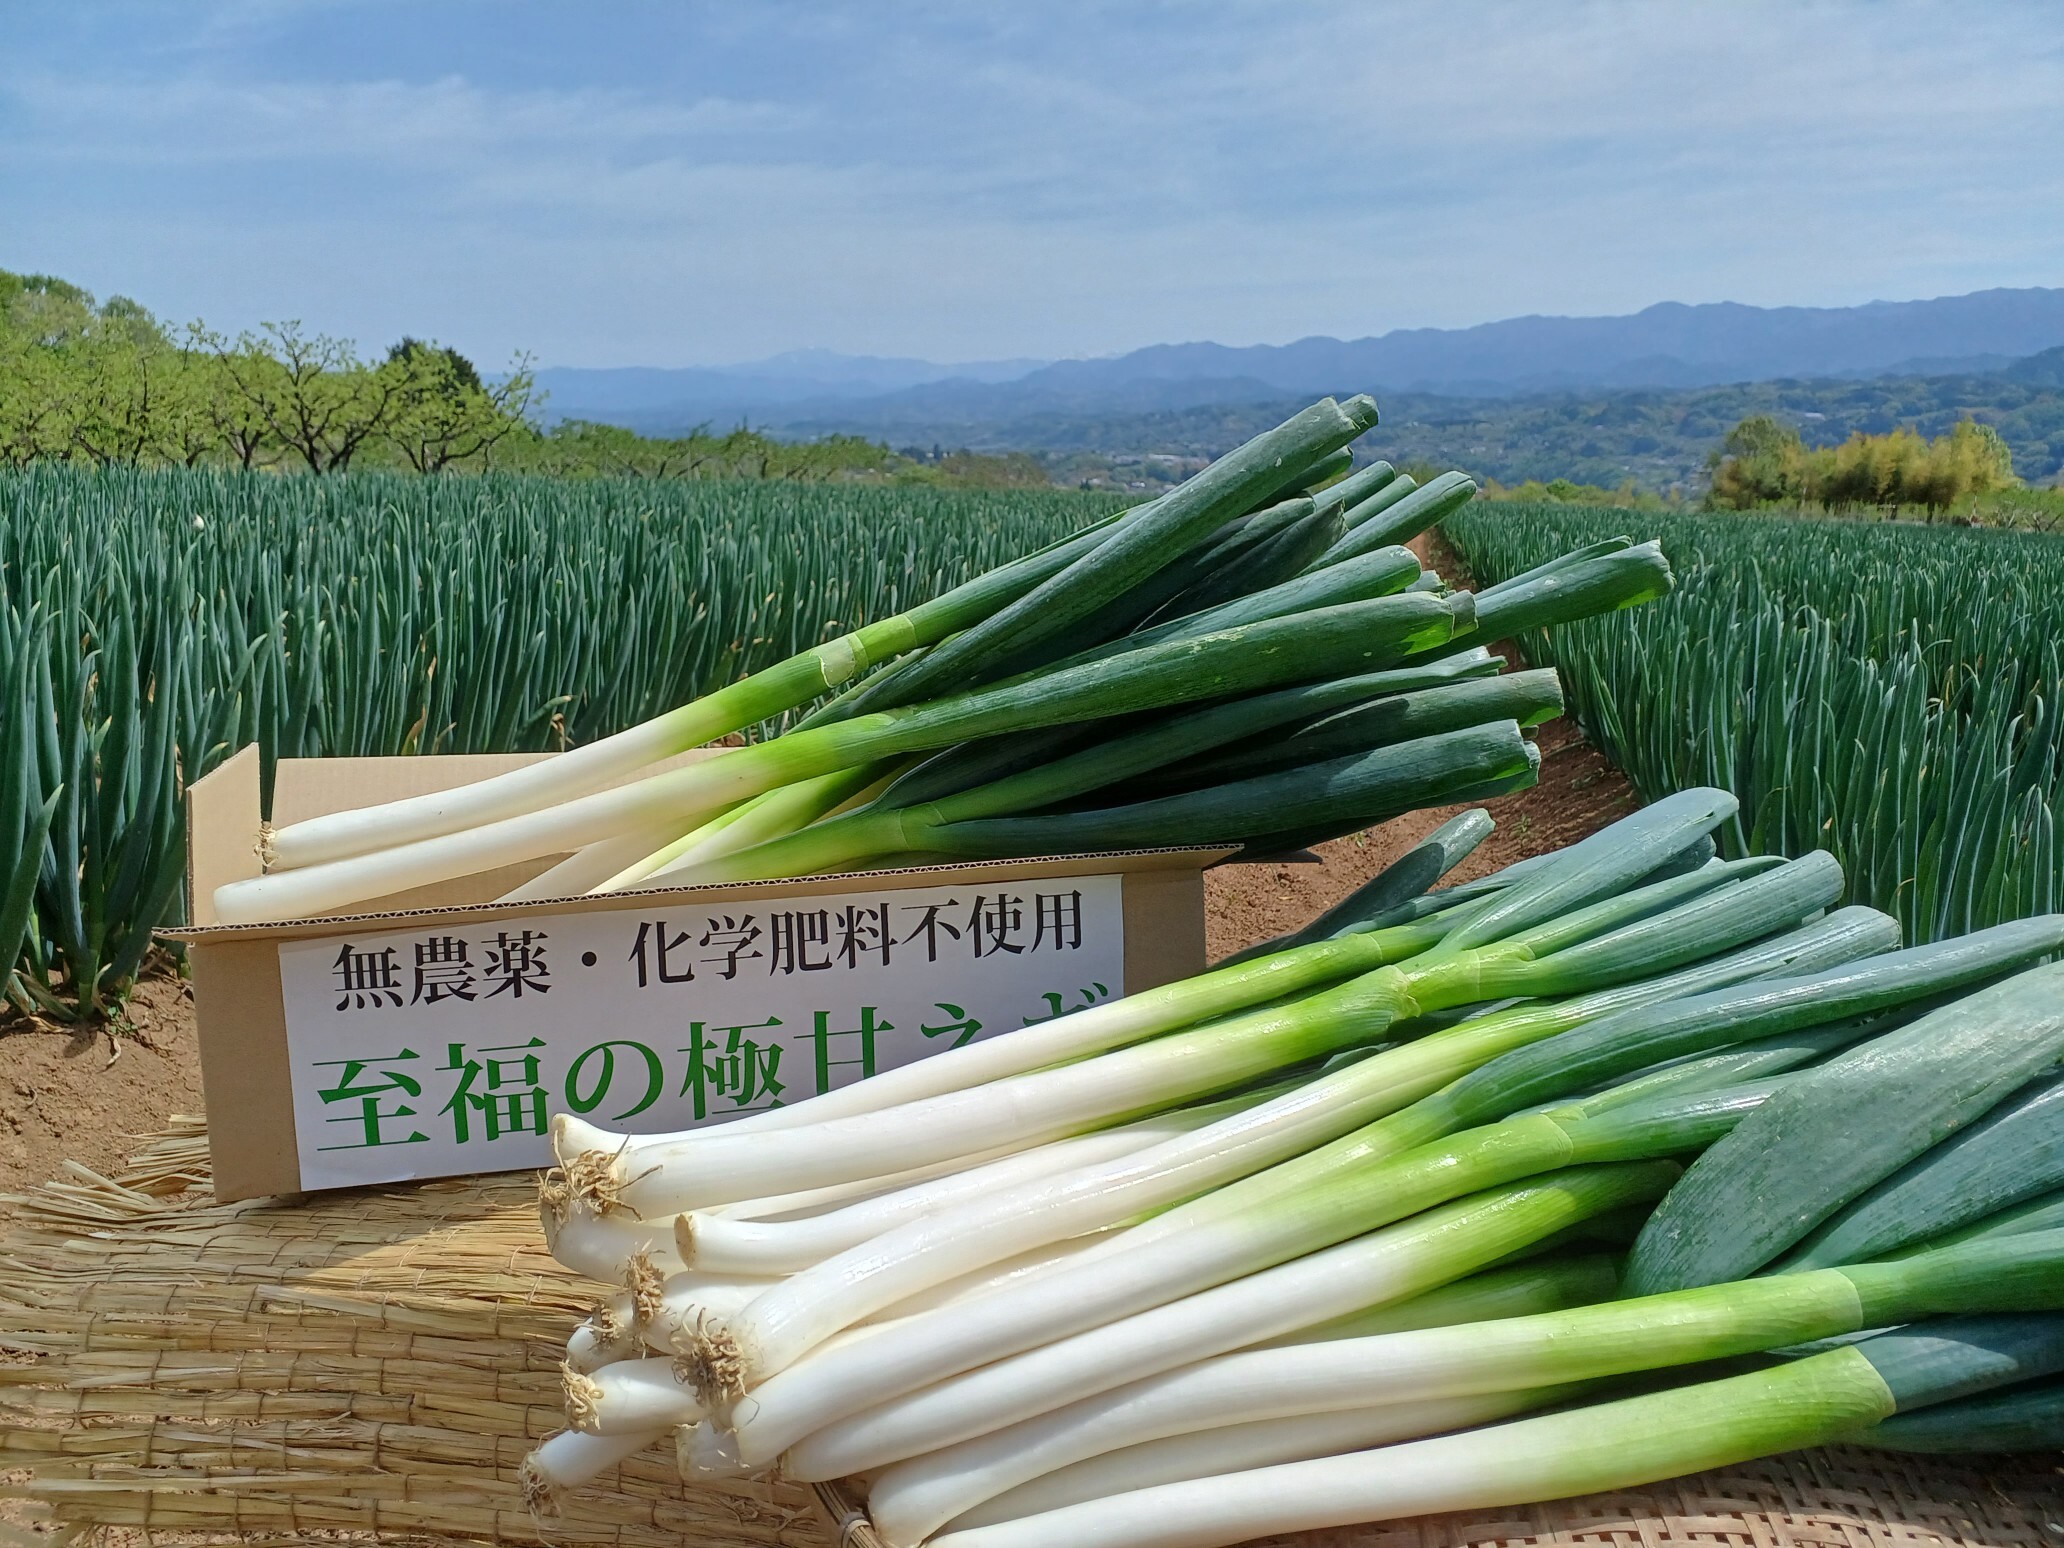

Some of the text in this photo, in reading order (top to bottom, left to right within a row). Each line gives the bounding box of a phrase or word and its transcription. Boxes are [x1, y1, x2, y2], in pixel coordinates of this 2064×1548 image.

[332, 889, 1083, 1011] 無農薬・化学肥料不使用
